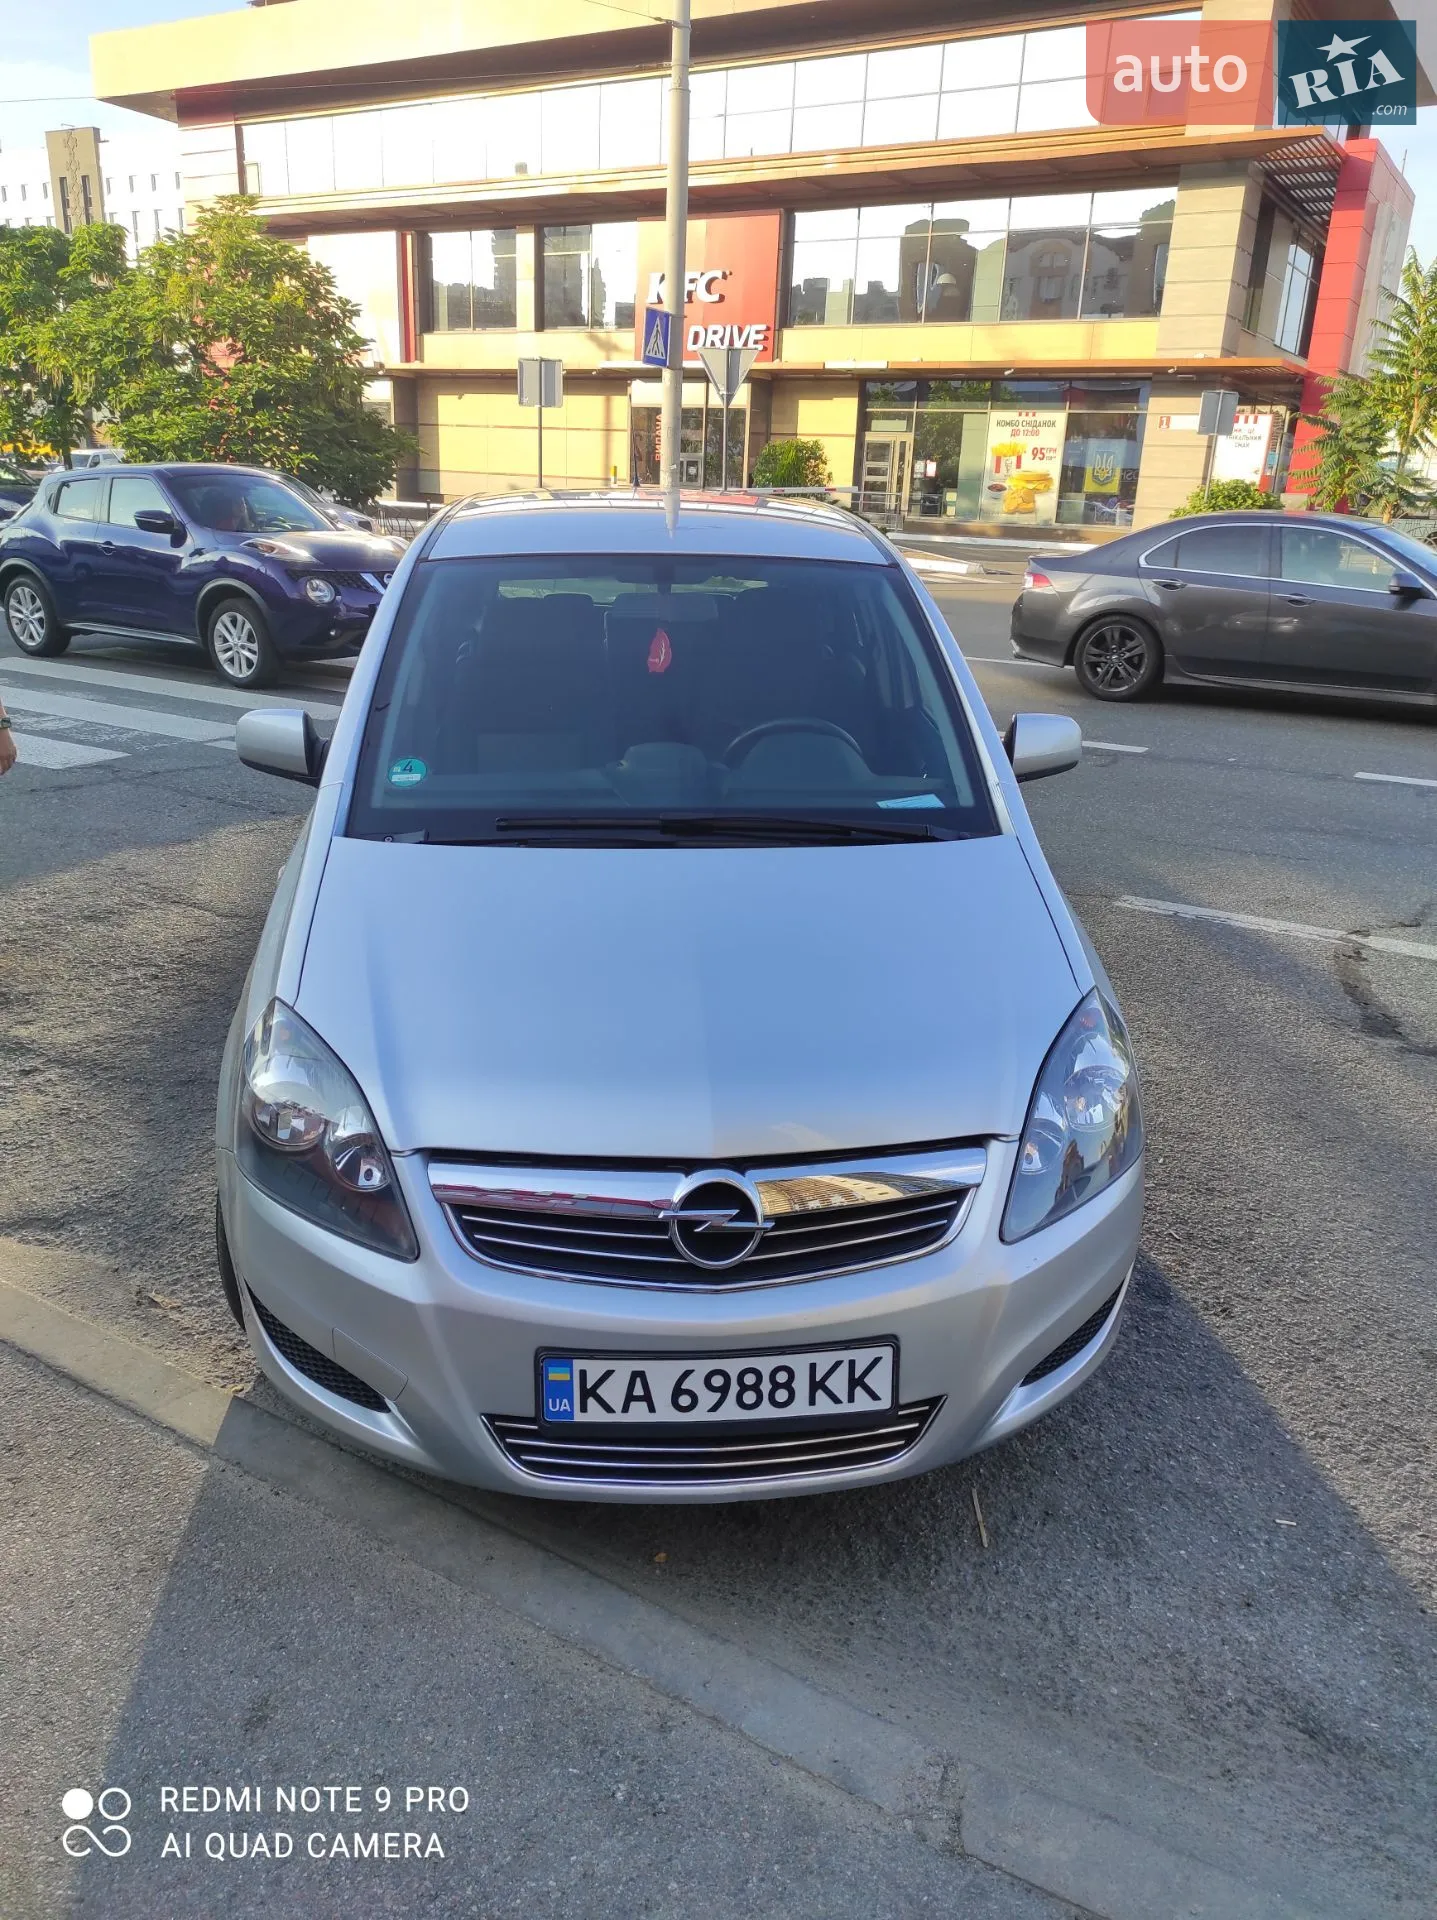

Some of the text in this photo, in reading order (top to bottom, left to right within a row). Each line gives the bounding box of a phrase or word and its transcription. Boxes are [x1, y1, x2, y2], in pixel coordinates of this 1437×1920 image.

[687, 324, 768, 352] DRIVE
[996, 419, 1057, 429] КОМБО СНІДАНОК
[1010, 429, 1040, 438] ДО 12:00
[1032, 447, 1046, 461] 95
[402, 759, 414, 773] 4
[670, 1364, 796, 1413] 6988
[548, 1398, 572, 1413] UA
